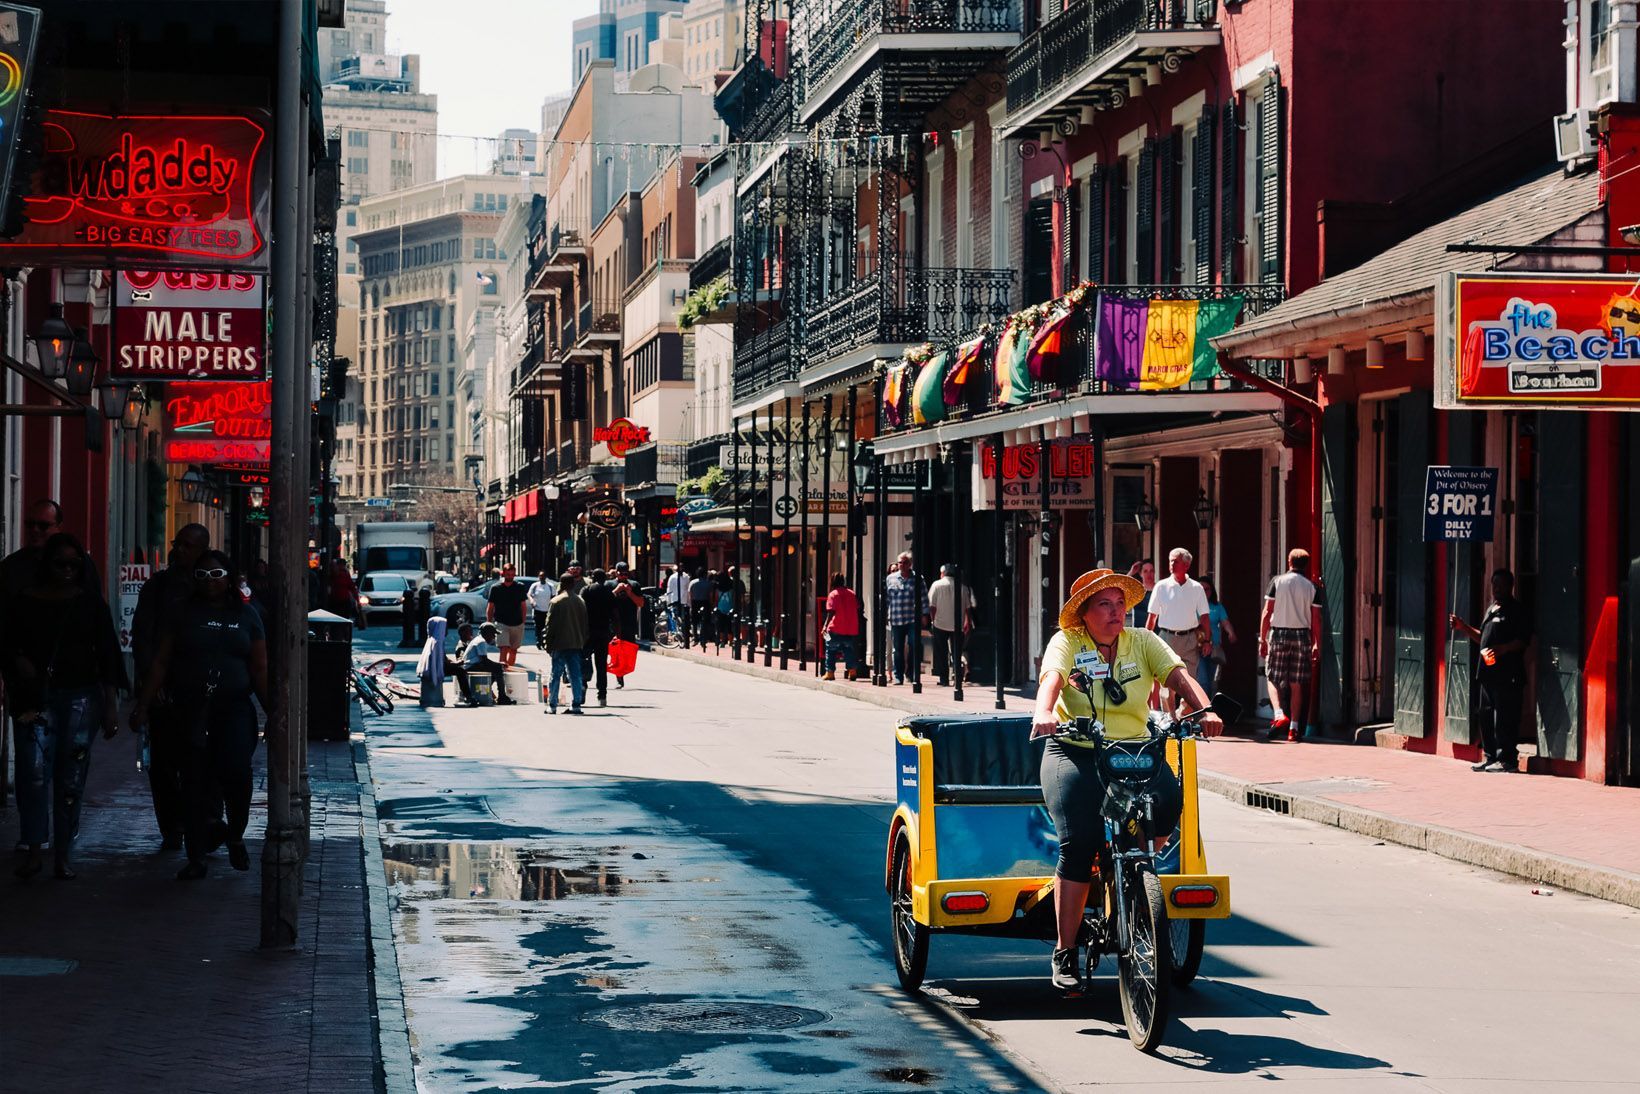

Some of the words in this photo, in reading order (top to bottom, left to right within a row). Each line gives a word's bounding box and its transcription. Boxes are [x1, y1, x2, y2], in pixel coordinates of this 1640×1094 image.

[128, 227, 186, 246] EASY
[191, 229, 240, 246] TEES
[144, 311, 233, 342] MALE
[1483, 326, 1640, 361] Beach
[119, 344, 257, 371] STRIPPERS
[982, 444, 1094, 479] HUSLER
[1434, 469, 1469, 479] Welcome
[1480, 470, 1492, 479] the
[1436, 480, 1448, 490] Pit
[1450, 480, 1458, 490] of
[1460, 481, 1488, 491] Misery
[777, 500, 796, 515] 33
[1427, 493, 1440, 515] 3
[1442, 493, 1478, 516] FOR
[1480, 494, 1492, 516] 1
[1445, 521, 1472, 529] DILLY
